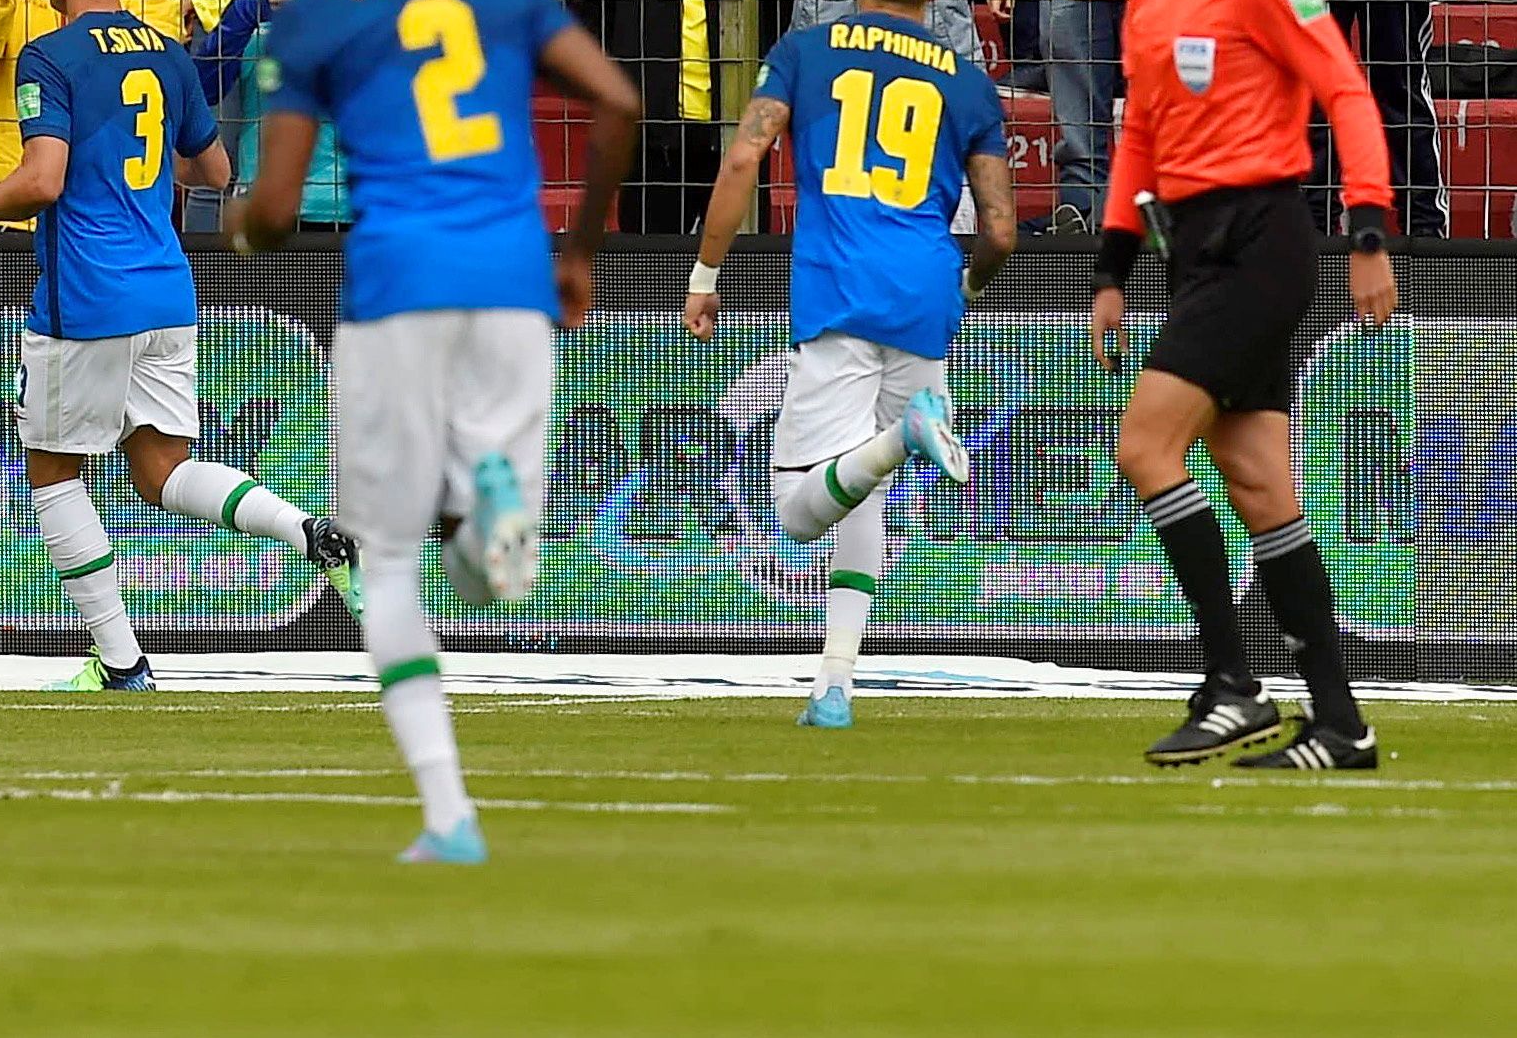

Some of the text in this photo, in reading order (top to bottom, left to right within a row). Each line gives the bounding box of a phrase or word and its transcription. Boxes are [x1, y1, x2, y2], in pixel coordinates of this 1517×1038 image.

[88, 27, 166, 54] T.SILVA
[829, 23, 957, 76] RAPHINHA
[121, 69, 165, 191] 3
[822, 68, 944, 209] 19
[1007, 134, 1048, 168] 21
